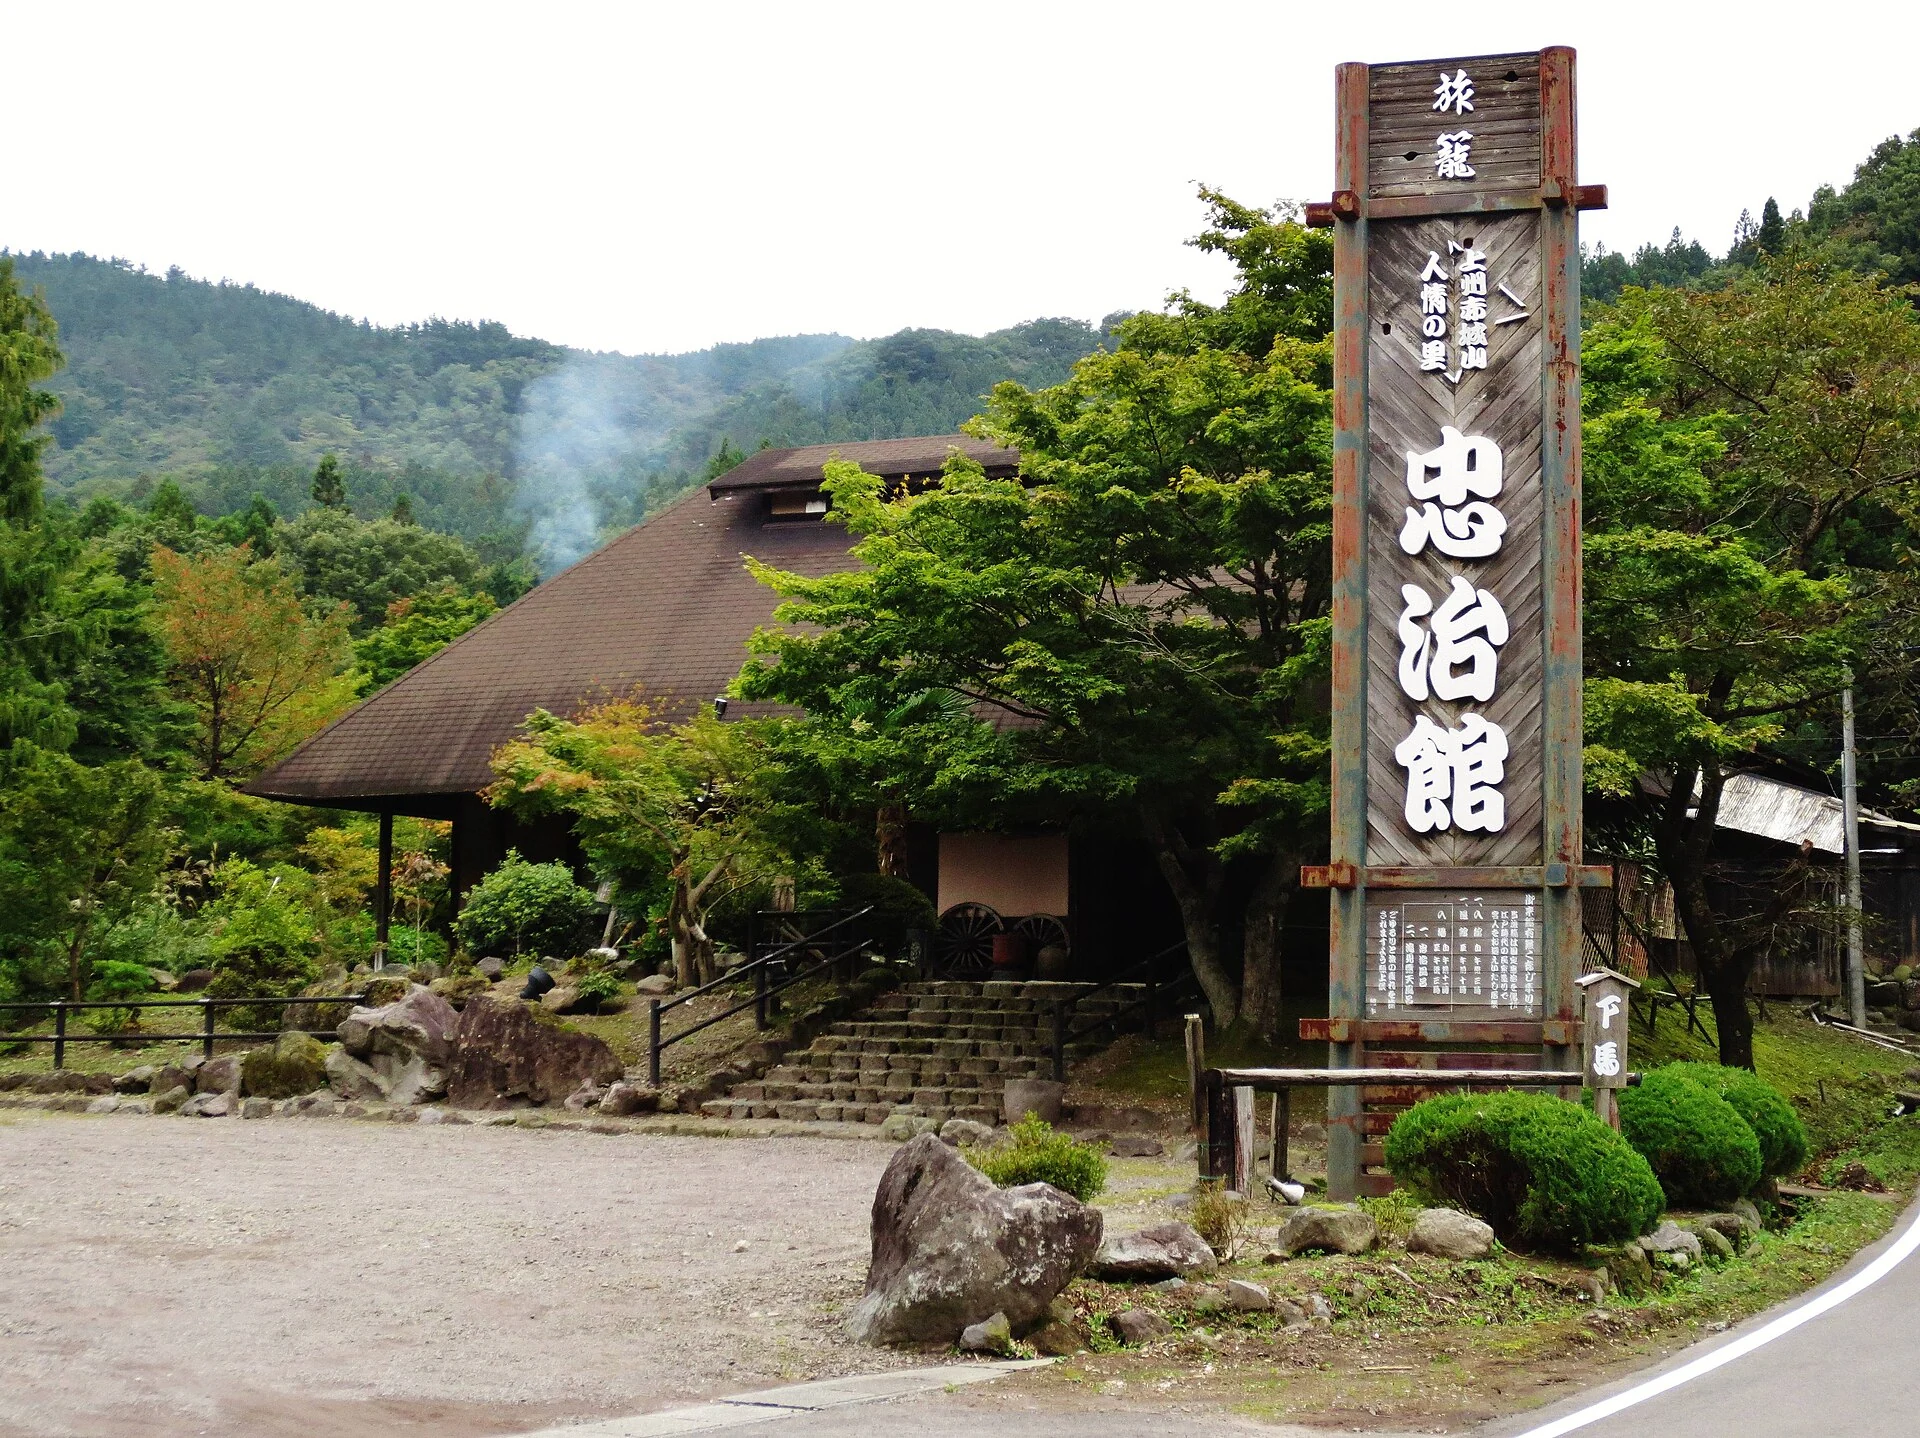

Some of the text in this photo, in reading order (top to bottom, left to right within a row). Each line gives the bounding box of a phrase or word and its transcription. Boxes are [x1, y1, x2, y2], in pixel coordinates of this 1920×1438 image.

[1432, 69, 1476, 179] 旅籠
[1420, 251, 1449, 371] 人情の里
[1458, 248, 1488, 370] 上州赤城山
[1395, 425, 1509, 834] 忠治館
[1593, 994, 1622, 1076] 下馬
